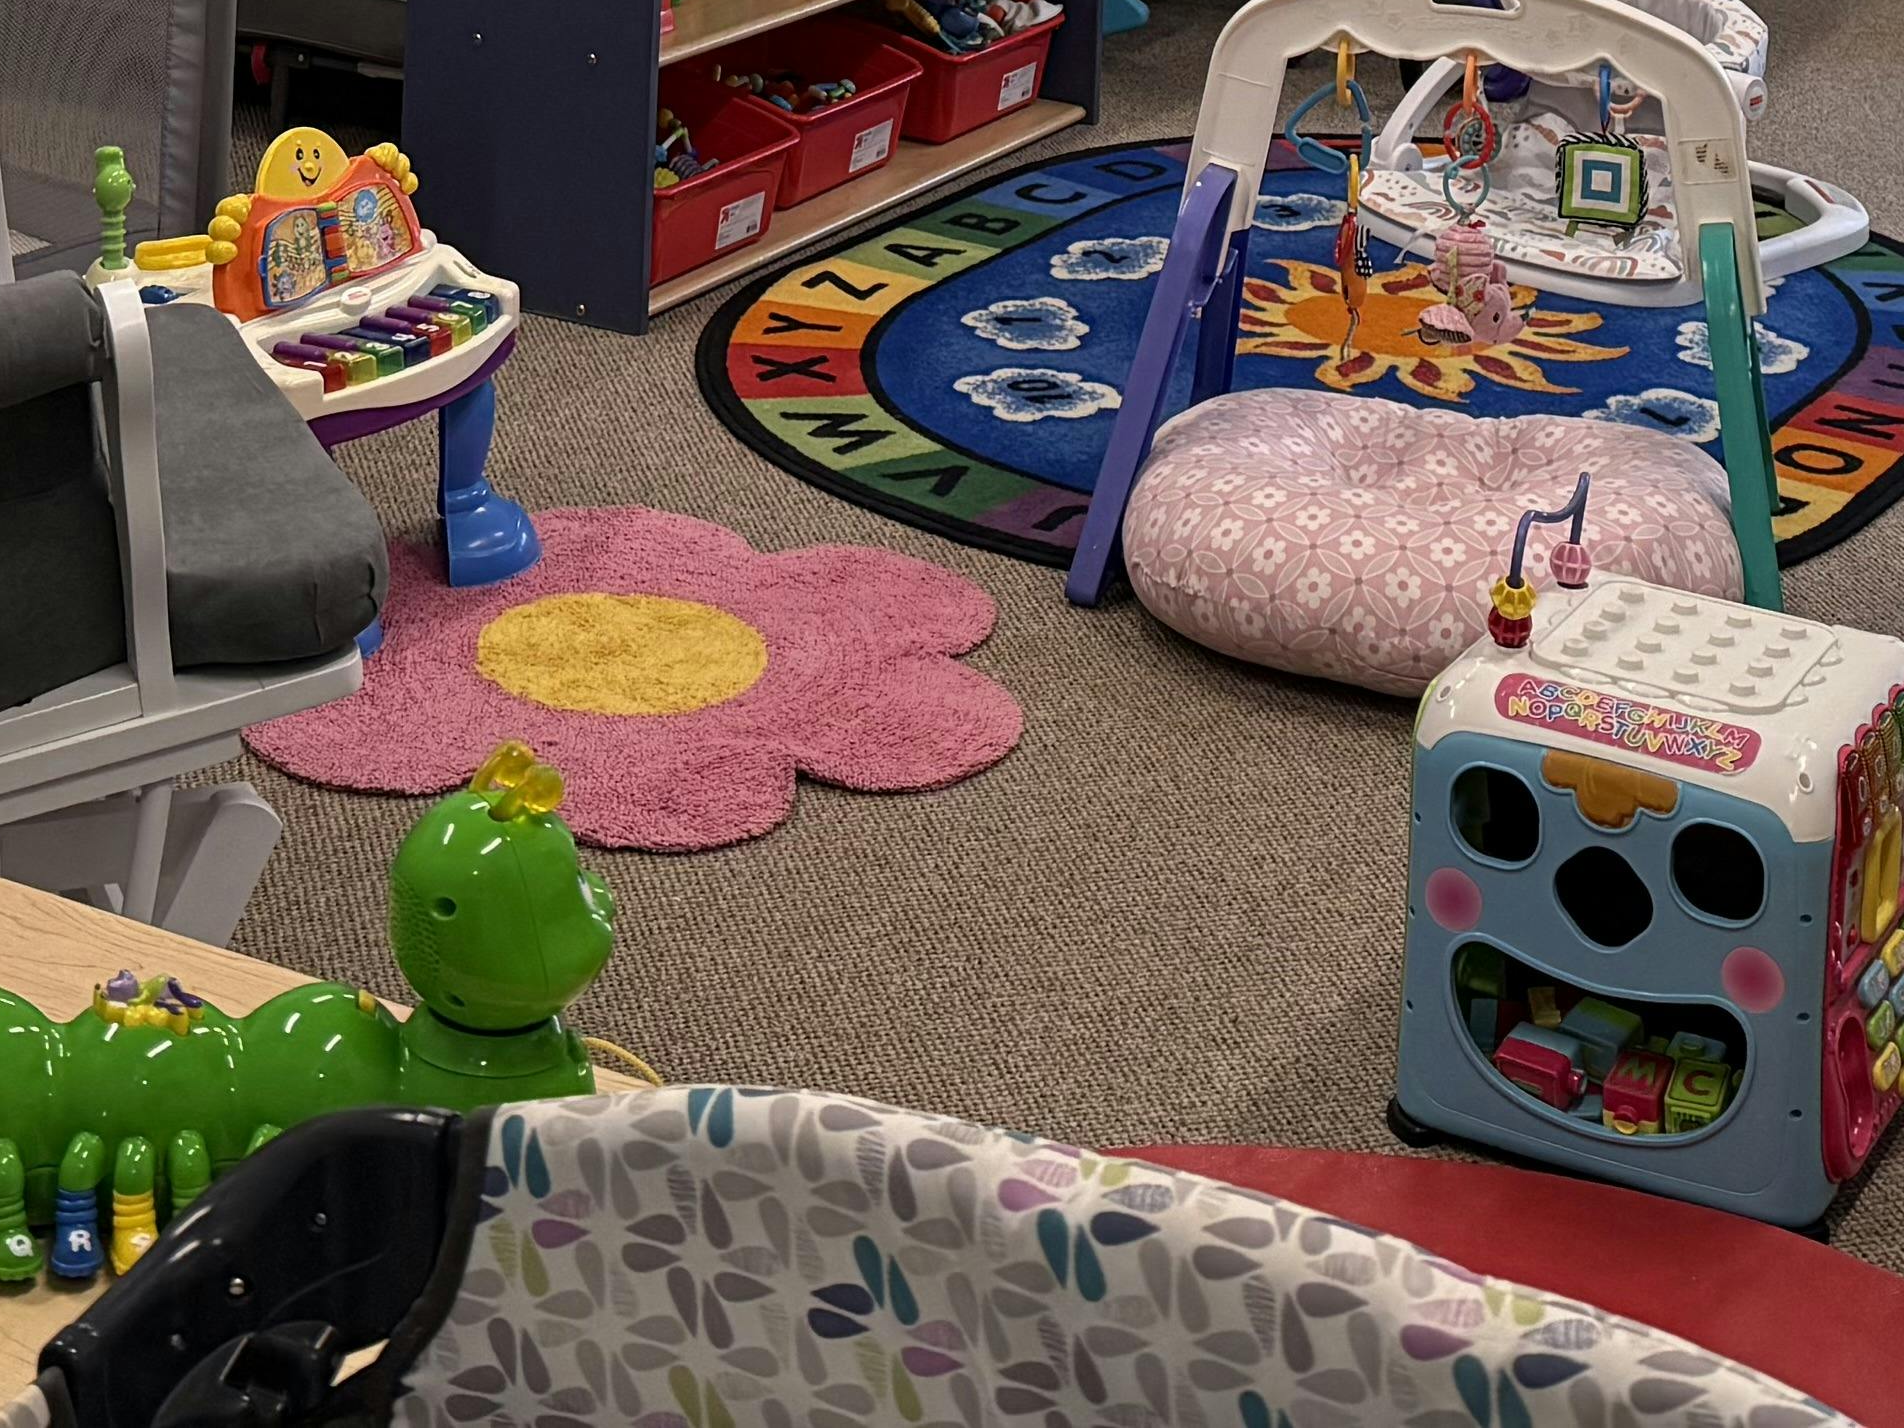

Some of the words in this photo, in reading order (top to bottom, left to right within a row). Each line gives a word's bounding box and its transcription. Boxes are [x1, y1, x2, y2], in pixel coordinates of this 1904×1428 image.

[884, 242, 967, 267] A
[942, 212, 1021, 235] B
[1015, 183, 1087, 204] C
[1095, 160, 1167, 181] D
[800, 270, 890, 300] Z
[761, 312, 842, 335] Y
[751, 355, 837, 383] X
[779, 411, 896, 454] W
[1774, 442, 1865, 476] O
[1617, 1058, 1656, 1085] M
[1683, 1071, 1716, 1096] C
[5, 1234, 34, 1257] Q
[69, 1229, 92, 1252] R
